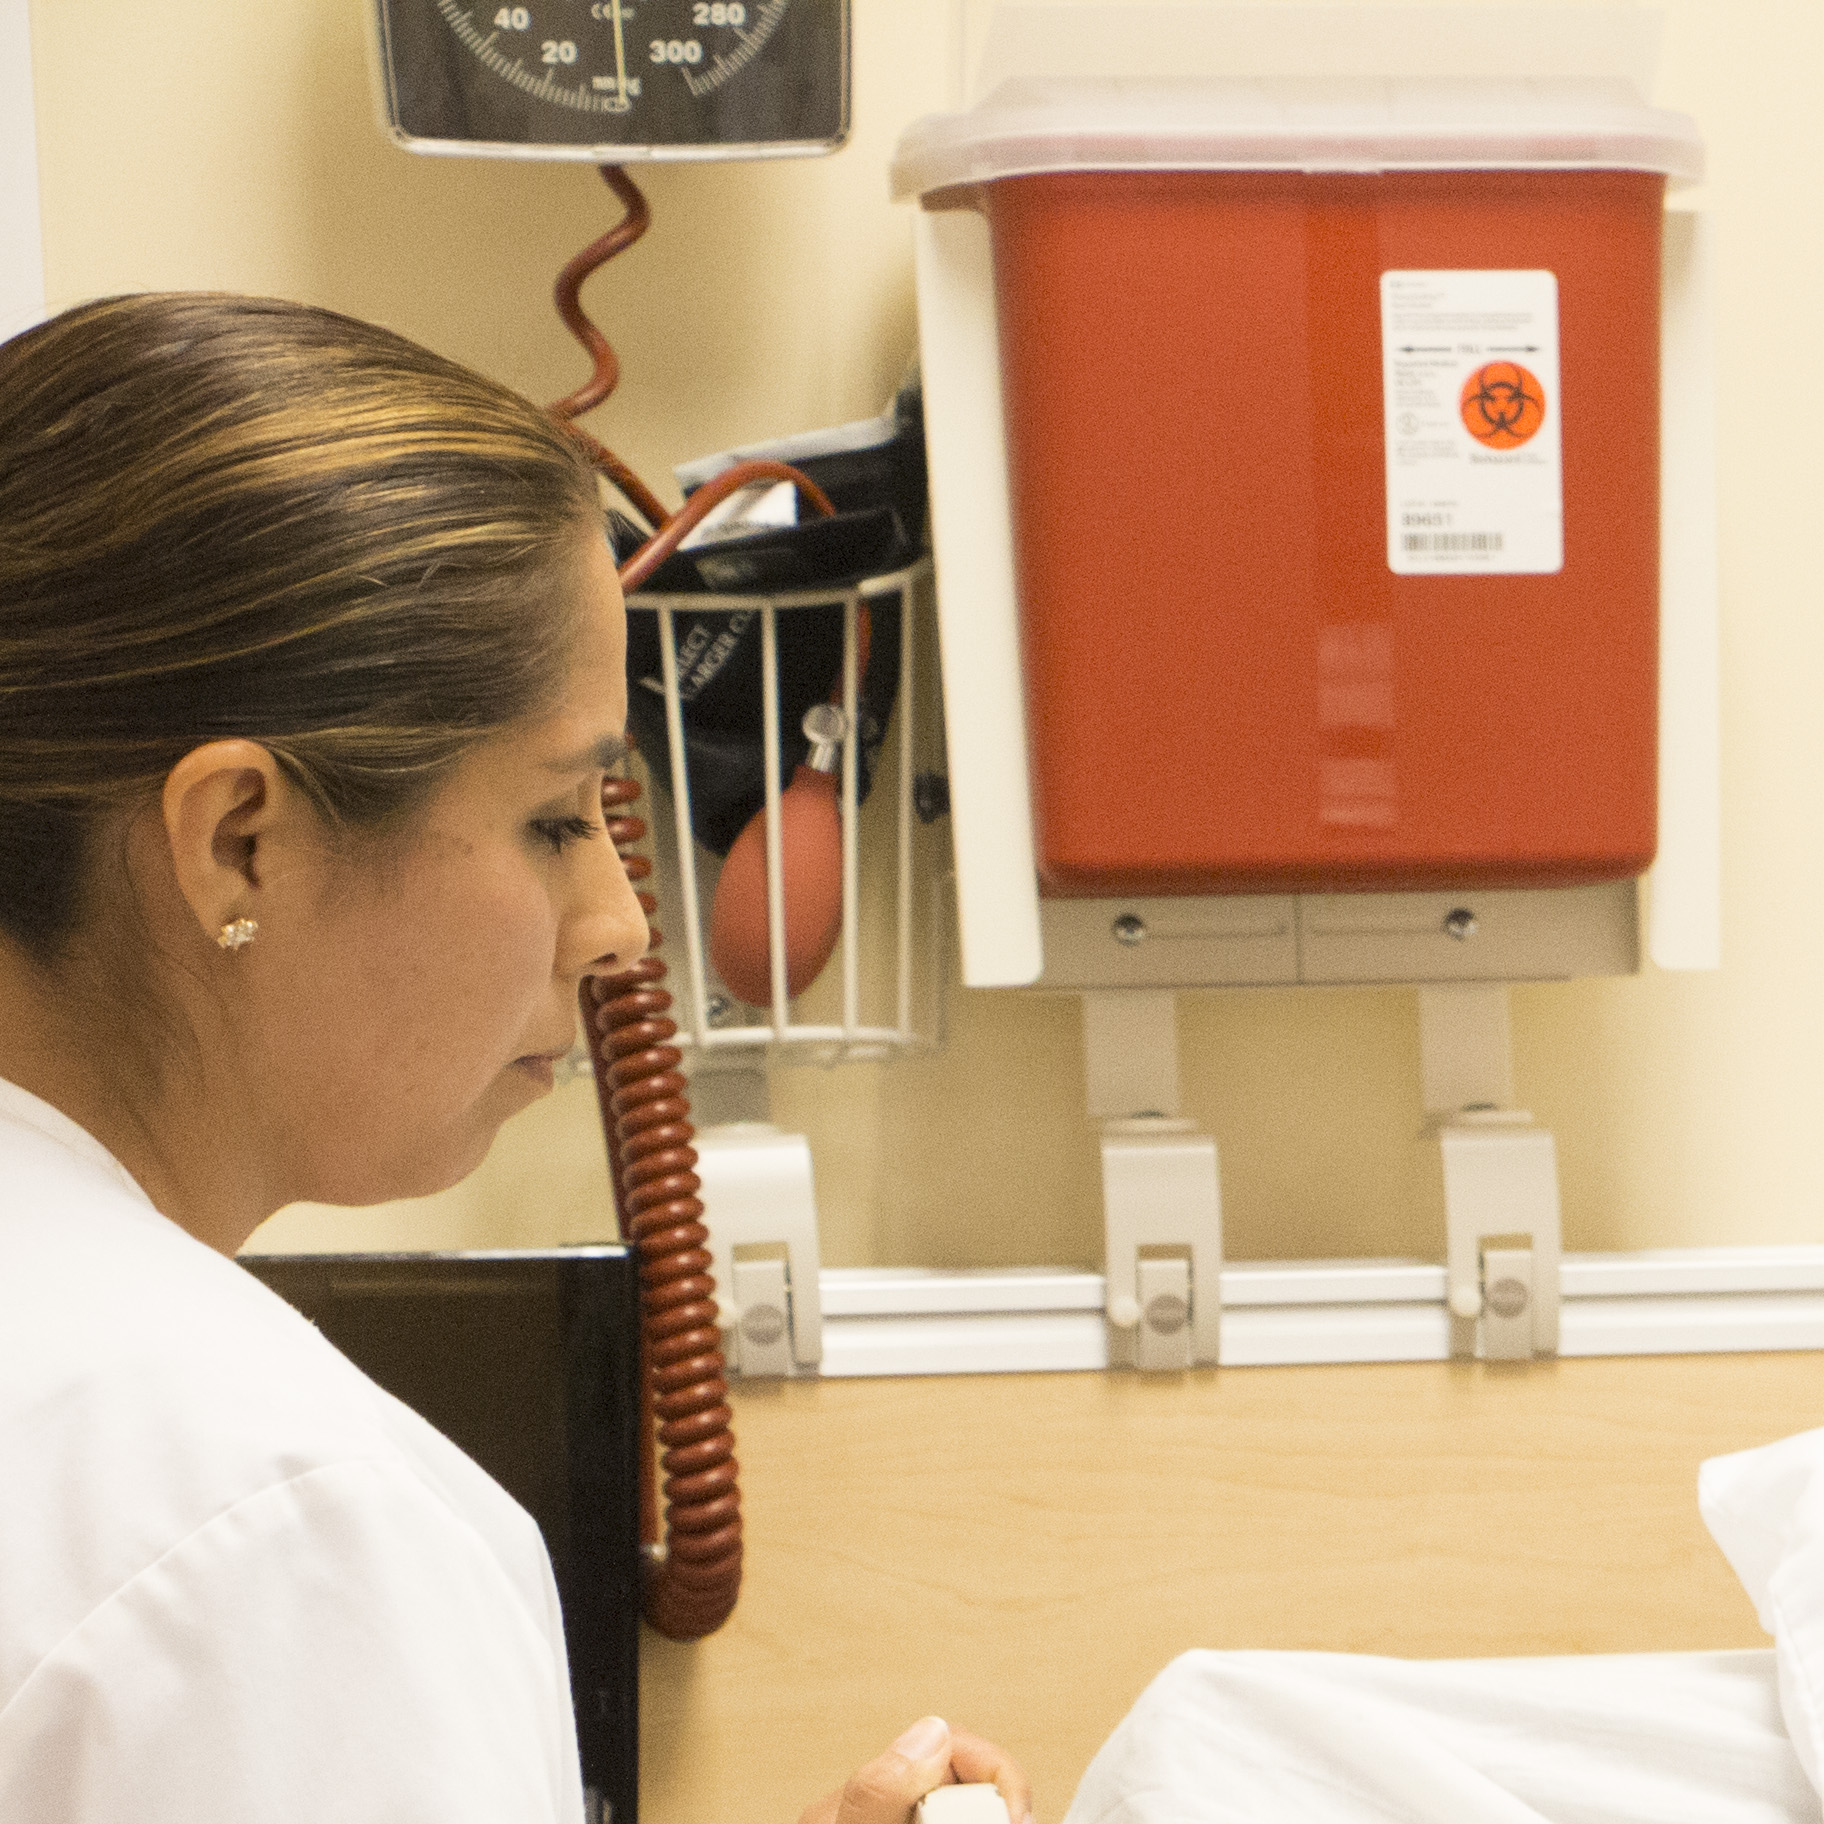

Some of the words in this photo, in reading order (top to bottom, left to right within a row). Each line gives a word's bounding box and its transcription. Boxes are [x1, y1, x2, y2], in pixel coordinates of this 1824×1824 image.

[494, 7, 532, 31] 40
[693, 2, 747, 27] 280
[541, 40, 579, 64] 20
[649, 40, 704, 64] 300
